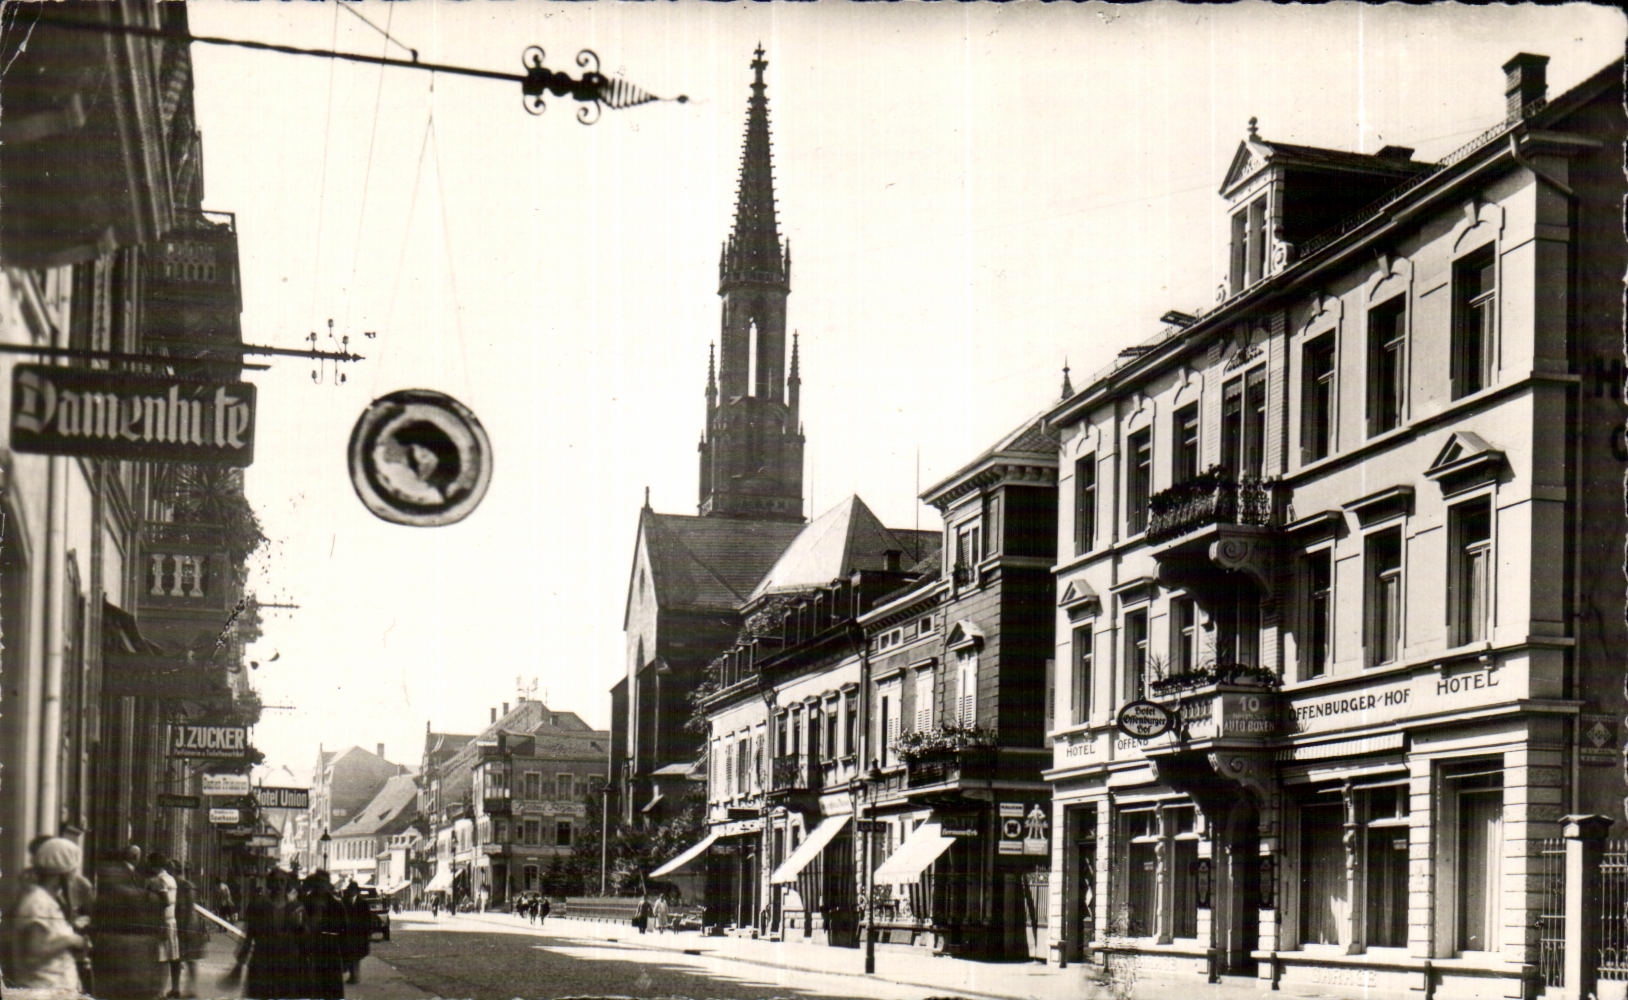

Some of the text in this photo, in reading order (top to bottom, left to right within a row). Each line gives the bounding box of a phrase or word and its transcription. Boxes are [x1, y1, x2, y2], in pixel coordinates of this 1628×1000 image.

[1437, 671, 1499, 696] HOTEL
[1239, 695, 1260, 712] 10
[1135, 706, 1155, 716] Hotel
[1123, 714, 1166, 727] Offenburger
[1137, 725, 1152, 735] Hof
[1066, 744, 1096, 758] HOTEL
[280, 789, 308, 807] Union
